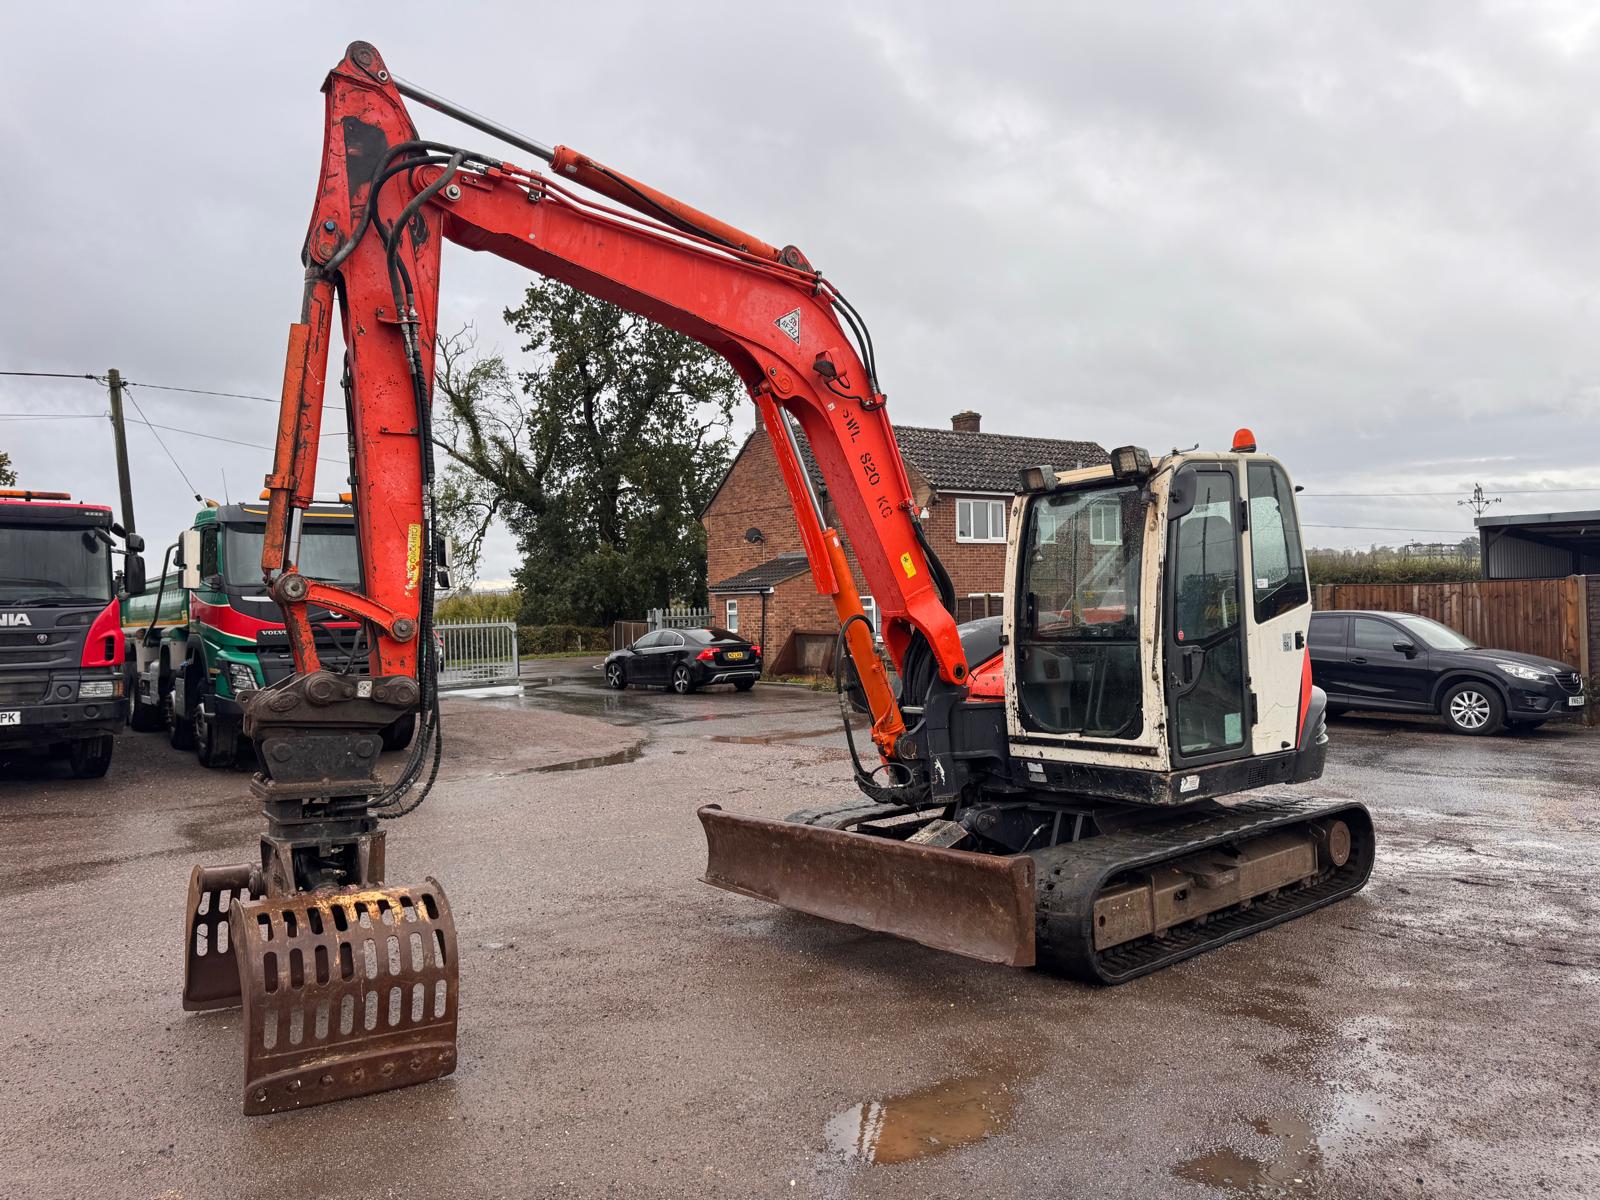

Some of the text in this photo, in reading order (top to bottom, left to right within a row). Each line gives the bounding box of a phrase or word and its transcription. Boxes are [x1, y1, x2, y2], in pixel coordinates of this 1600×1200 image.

[842, 408, 894, 519] SWL 820 KG
[0, 713, 16, 723] PK
